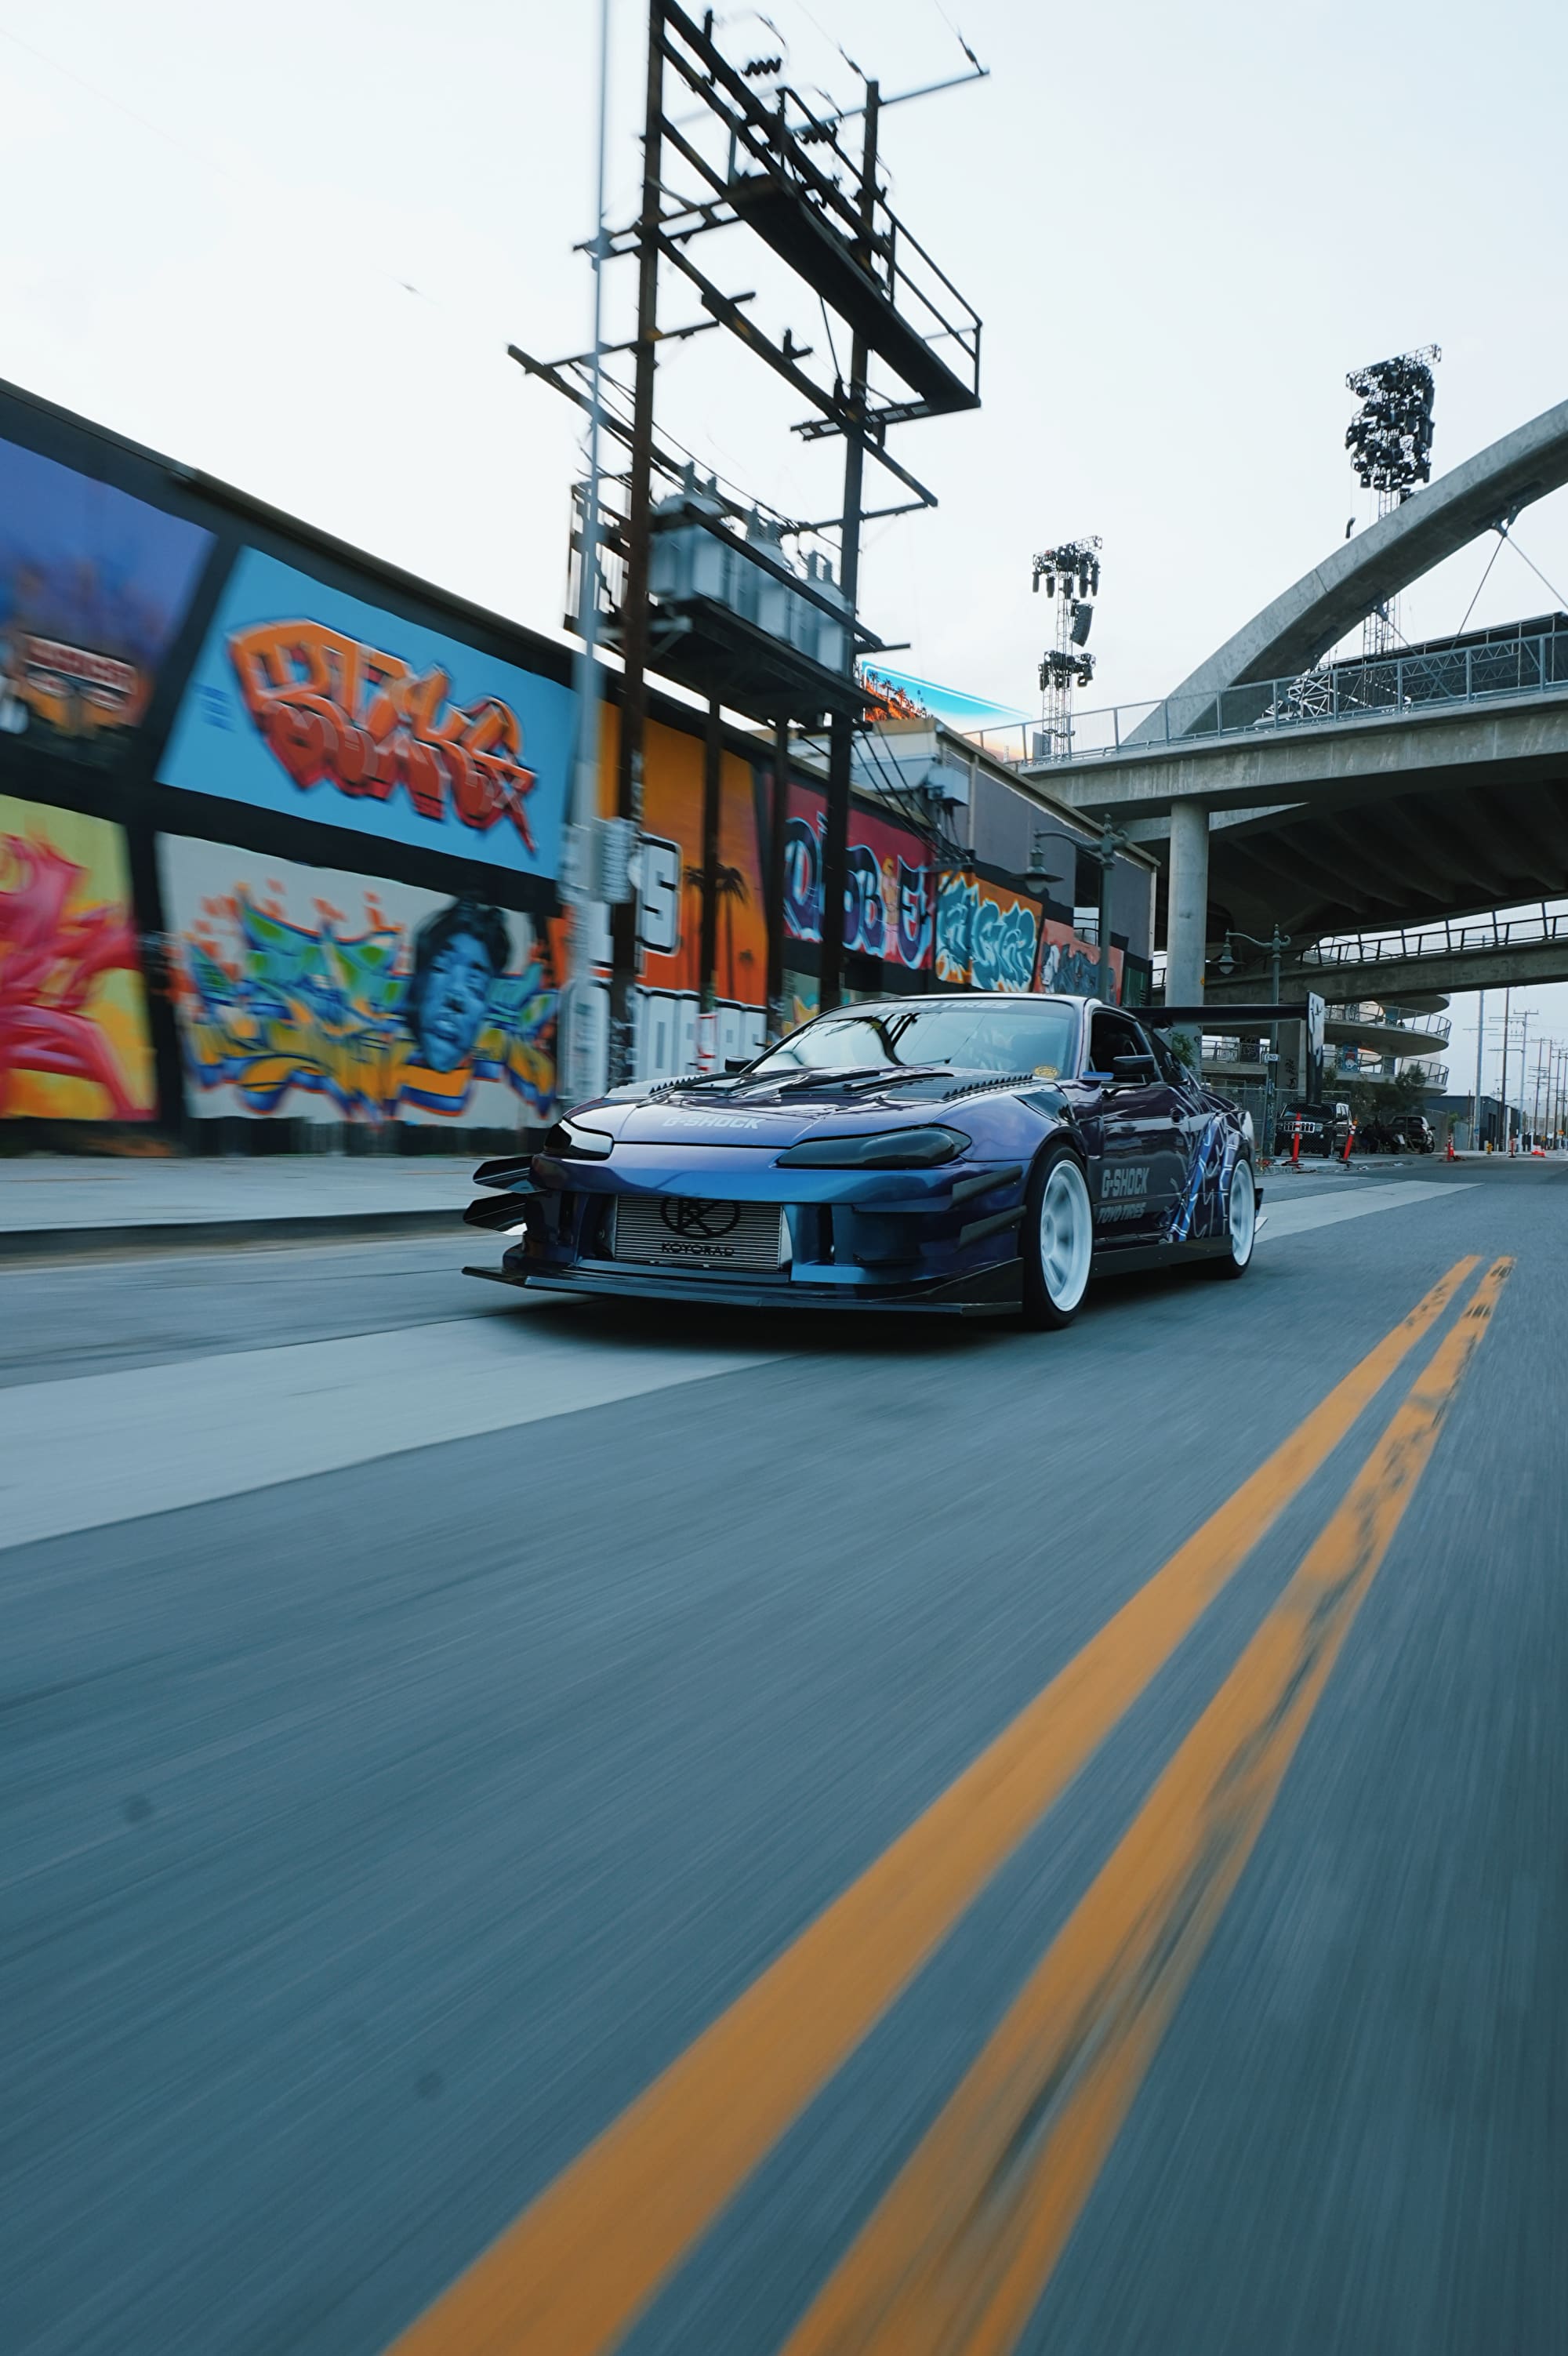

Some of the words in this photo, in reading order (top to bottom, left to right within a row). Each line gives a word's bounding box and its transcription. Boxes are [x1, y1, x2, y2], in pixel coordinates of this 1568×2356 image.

[876, 1002, 940, 1011] TOYO
[662, 1116, 766, 1130] G-SHOCK
[1101, 1167, 1150, 1199] G-SHOCK
[1097, 1205, 1123, 1224] TOYO
[1120, 1202, 1147, 1221] TIRES
[661, 1242, 735, 1256] KOYORAD
